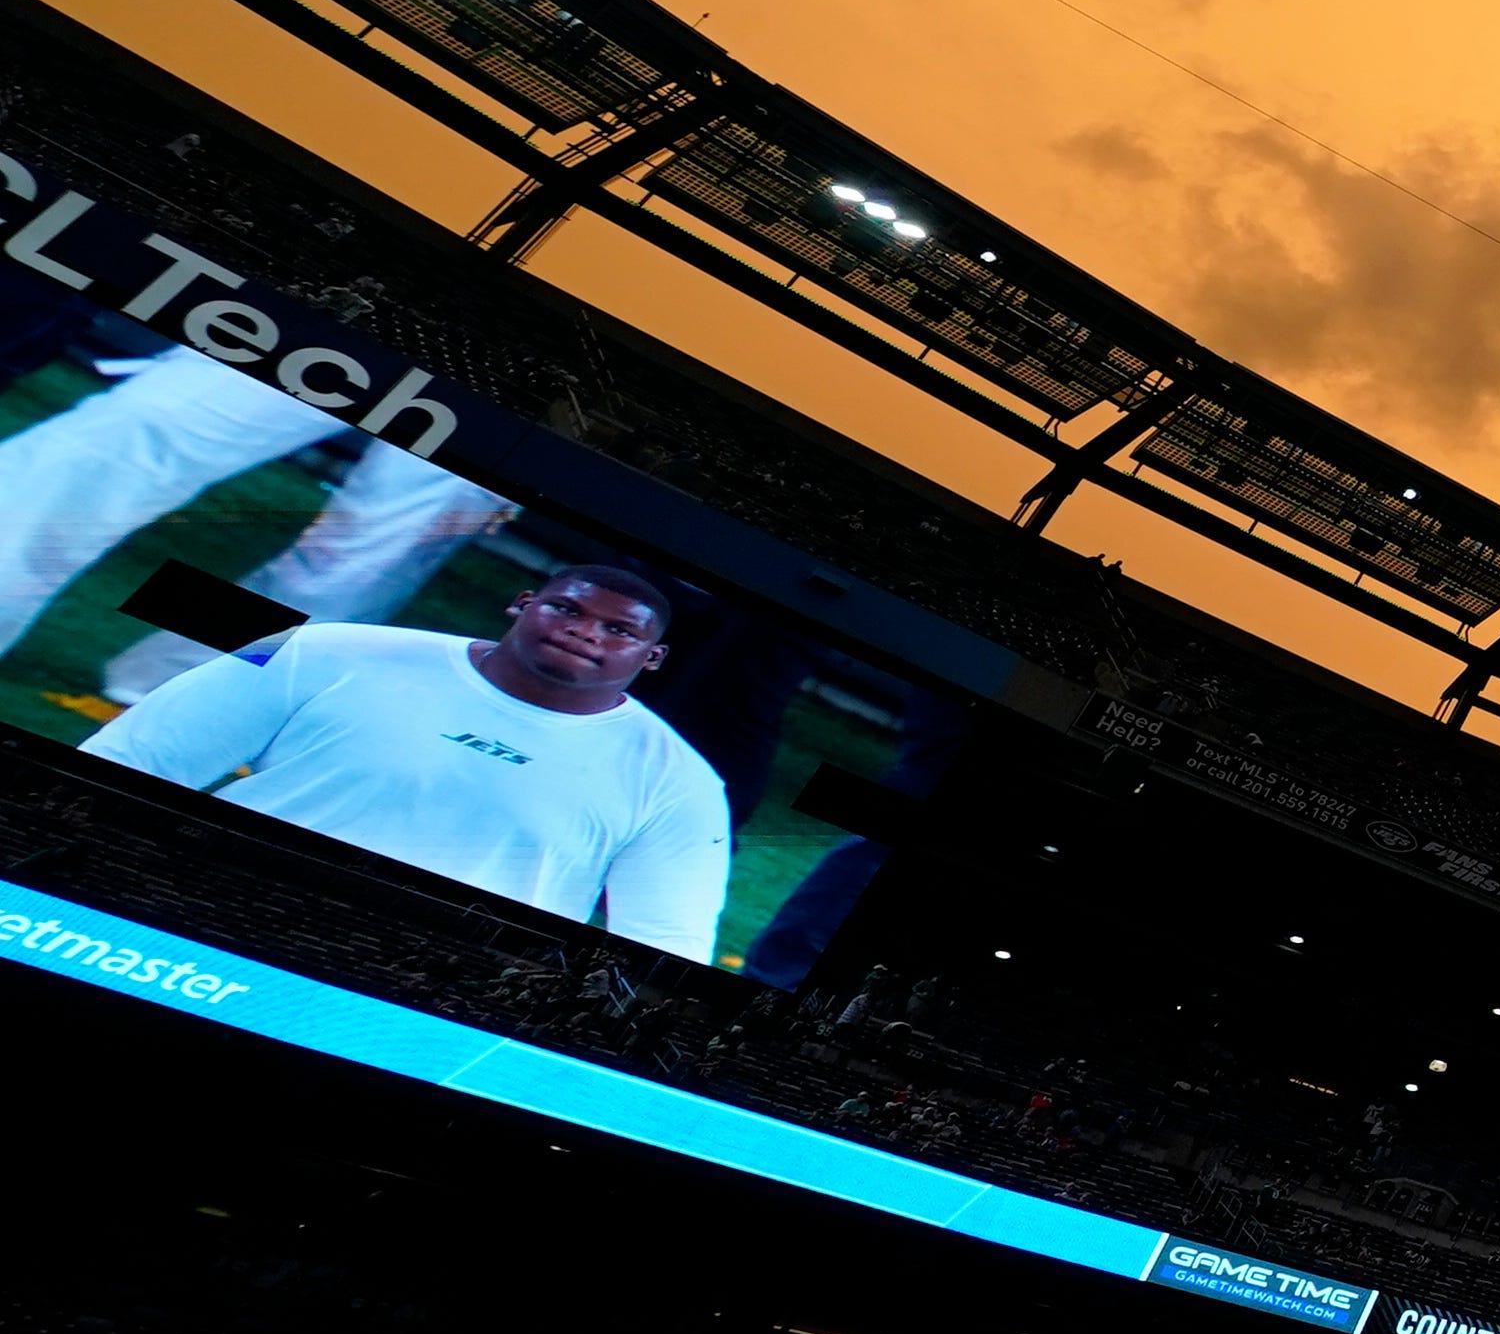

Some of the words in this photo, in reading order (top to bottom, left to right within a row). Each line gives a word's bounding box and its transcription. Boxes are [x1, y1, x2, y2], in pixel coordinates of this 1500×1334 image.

[1096, 717, 1162, 751] Help?
[1105, 701, 1163, 735] Need
[440, 732, 534, 766] JETS
[1186, 757, 1203, 772] or
[1206, 761, 1241, 787] call
[1240, 781, 1350, 831] 201.559.1515
[1195, 741, 1232, 765] Text
[1289, 777, 1305, 796] to
[1306, 785, 1357, 816] 78247
[1421, 840, 1495, 876] FANS
[1169, 1246, 1274, 1287] GAME
[1275, 1272, 1359, 1310] TIME
[1174, 1269, 1337, 1321] GAMETIMEWATCH.COM
